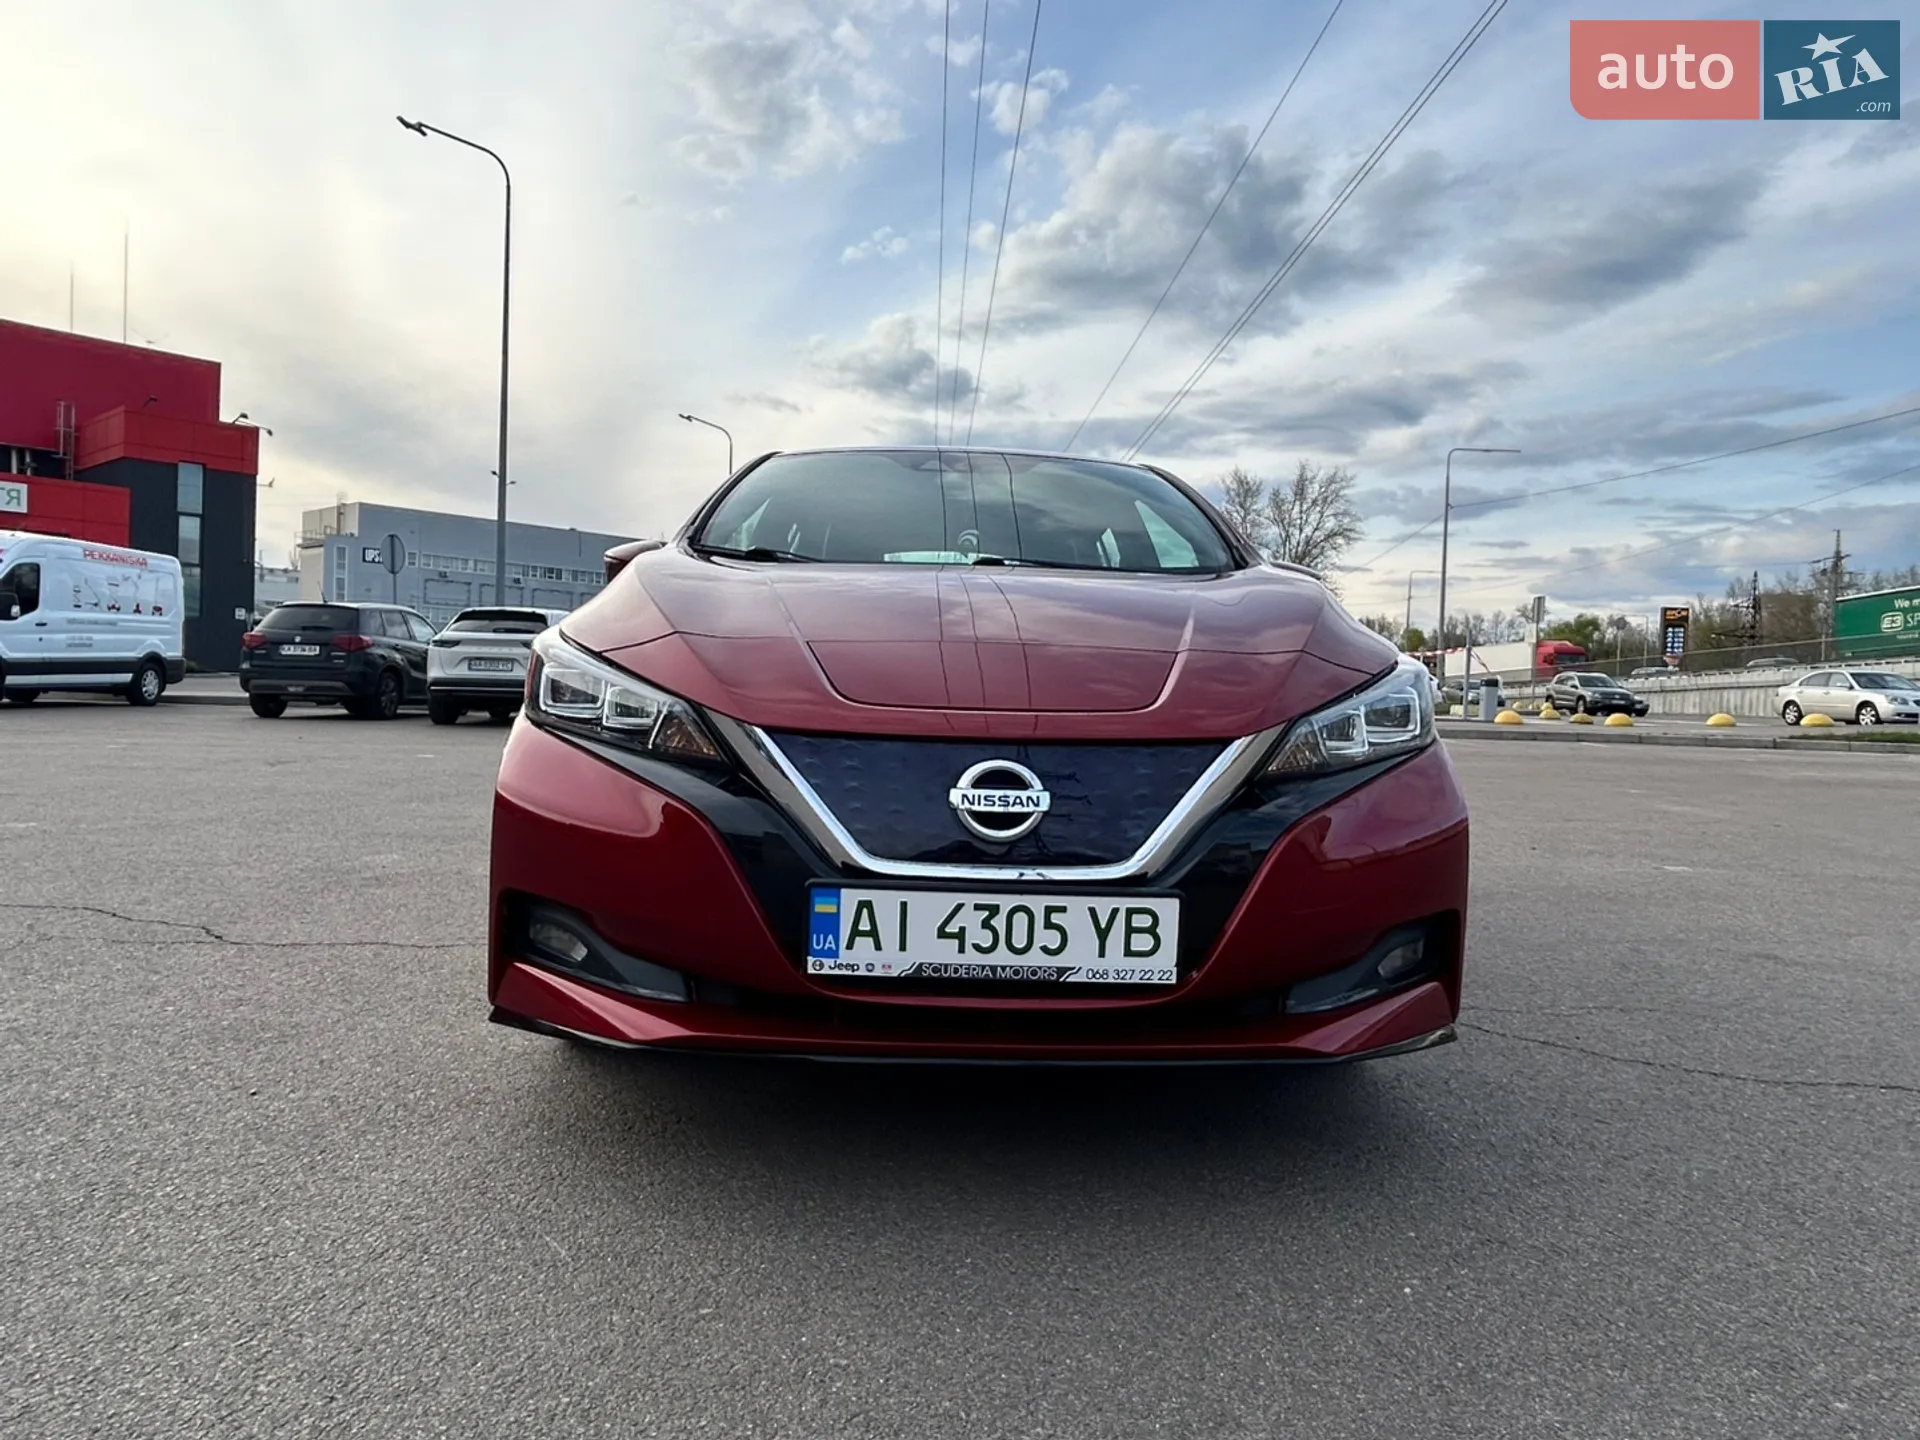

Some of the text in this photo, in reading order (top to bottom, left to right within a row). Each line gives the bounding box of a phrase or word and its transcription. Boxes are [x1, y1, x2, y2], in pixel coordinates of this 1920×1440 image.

[0, 487, 21, 507] Я
[365, 549, 383, 563] UPS
[1894, 599, 1911, 609] We
[961, 793, 1040, 808] NISSAN
[812, 899, 1162, 959] UA AI 4305 YB
[828, 960, 1173, 981] Jeep SCUDERIA MOTORS 068 327 22 22
